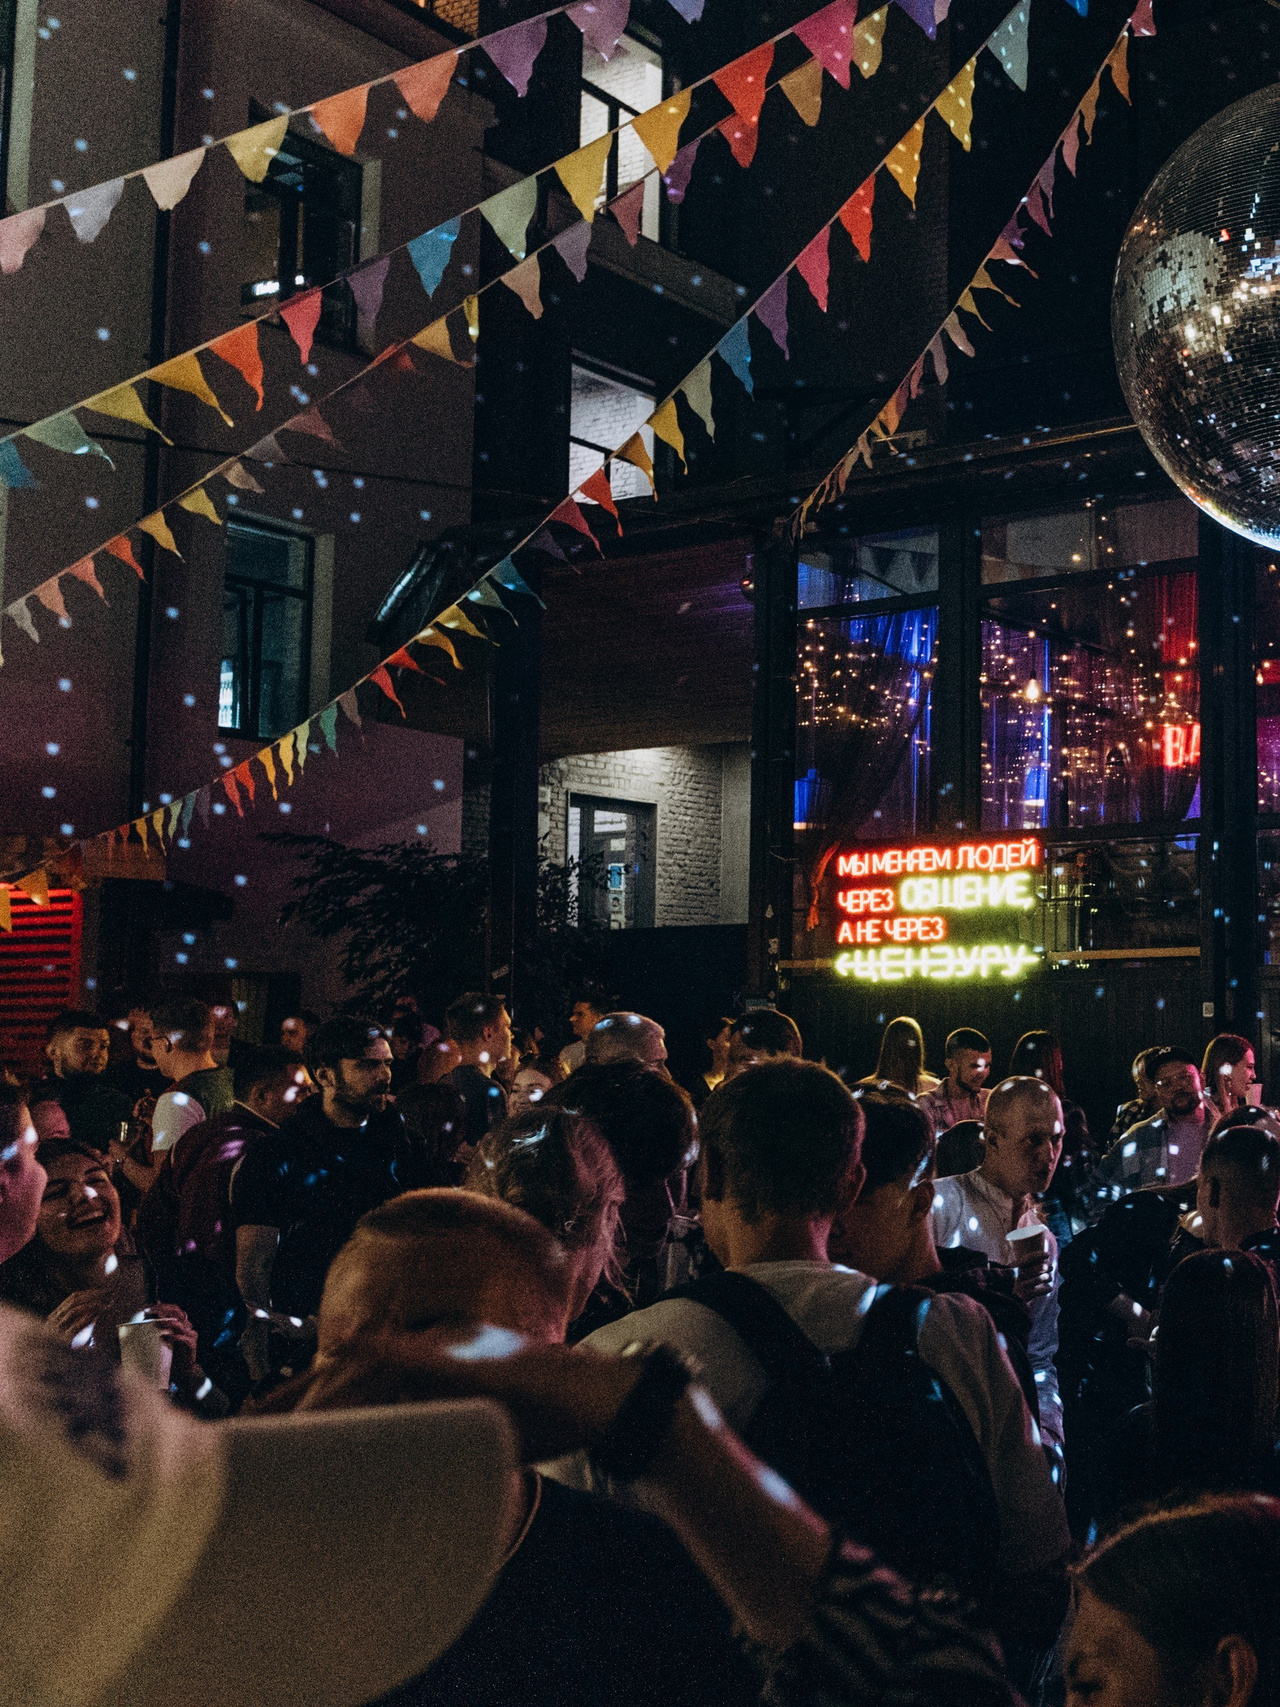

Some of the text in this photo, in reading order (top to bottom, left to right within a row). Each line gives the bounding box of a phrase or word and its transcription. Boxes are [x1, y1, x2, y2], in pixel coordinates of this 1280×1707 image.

[838, 838, 1037, 877] МЫ МЕНЯЕМ ЛЮДЕЙ
[837, 888, 895, 913] ЧЕРЕЗ
[837, 916, 945, 944] А НЕ ЧЕРЕЗ
[853, 945, 1026, 983] ЦЕНЗУРУ
